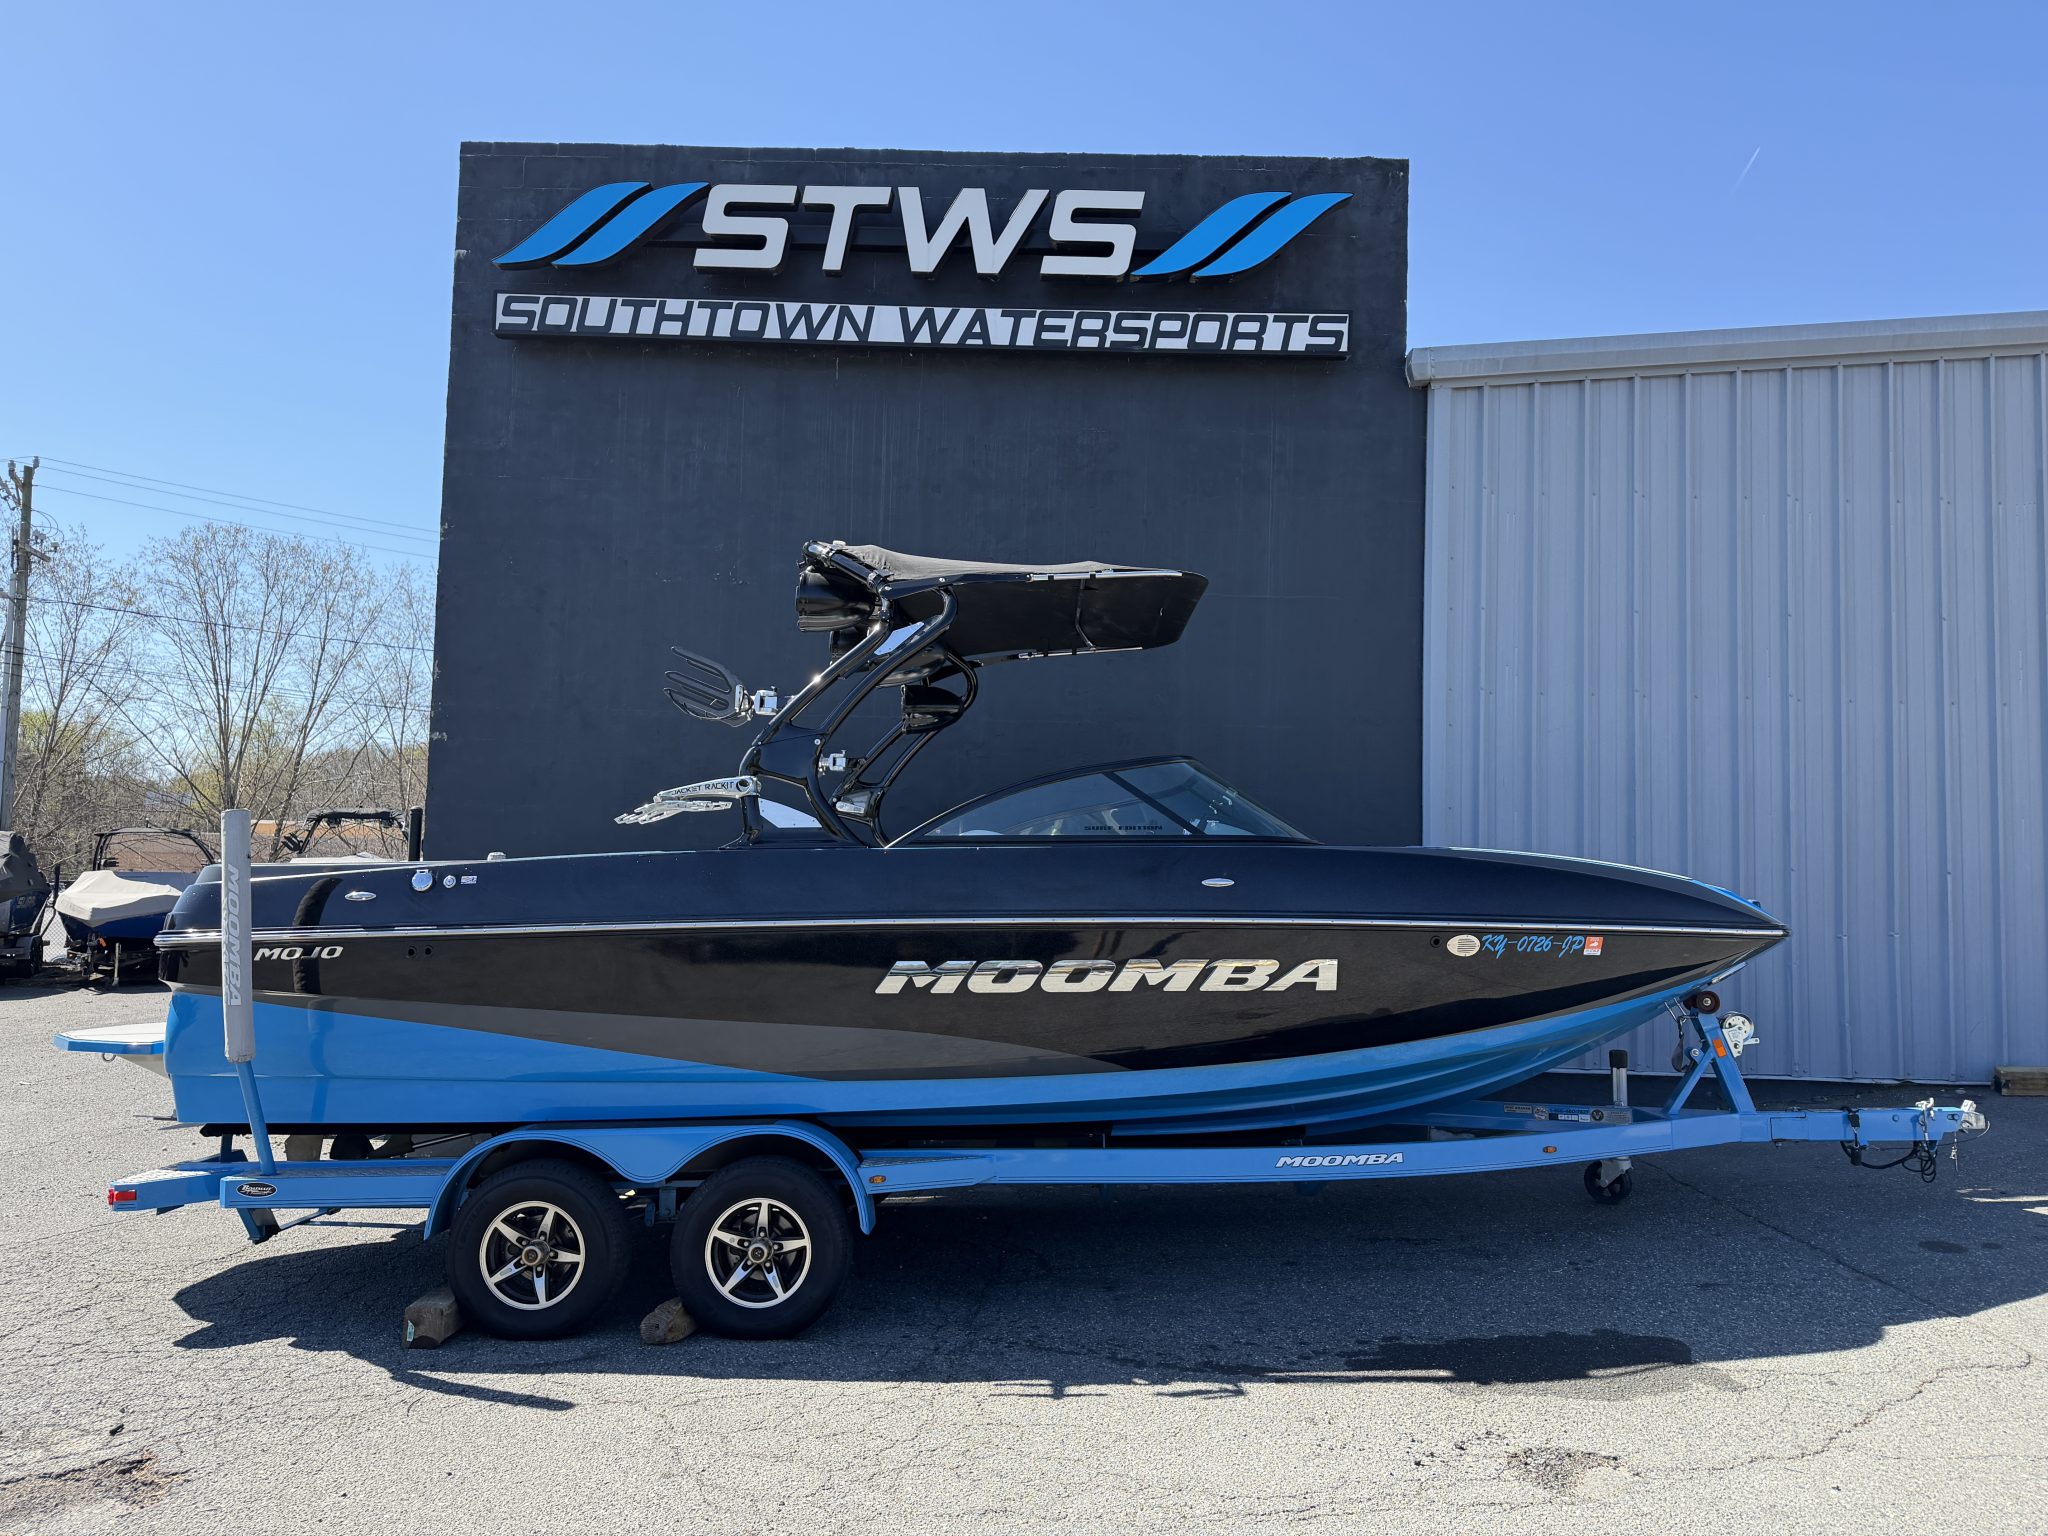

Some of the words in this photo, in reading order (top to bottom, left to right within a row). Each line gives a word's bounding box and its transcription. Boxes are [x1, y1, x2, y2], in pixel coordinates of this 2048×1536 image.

[693, 183, 1146, 276] STWS
[500, 294, 876, 343] SOUTHTOWN
[898, 306, 1349, 353] WATERSPORTS
[671, 785, 702, 796] JACKET
[704, 781, 735, 791] RACKIT
[227, 863, 242, 1006] MOOMBA
[253, 945, 344, 961] MOJO
[874, 958, 1339, 994] MOOMBA
[1275, 1152, 1404, 1168] MOOMBA
